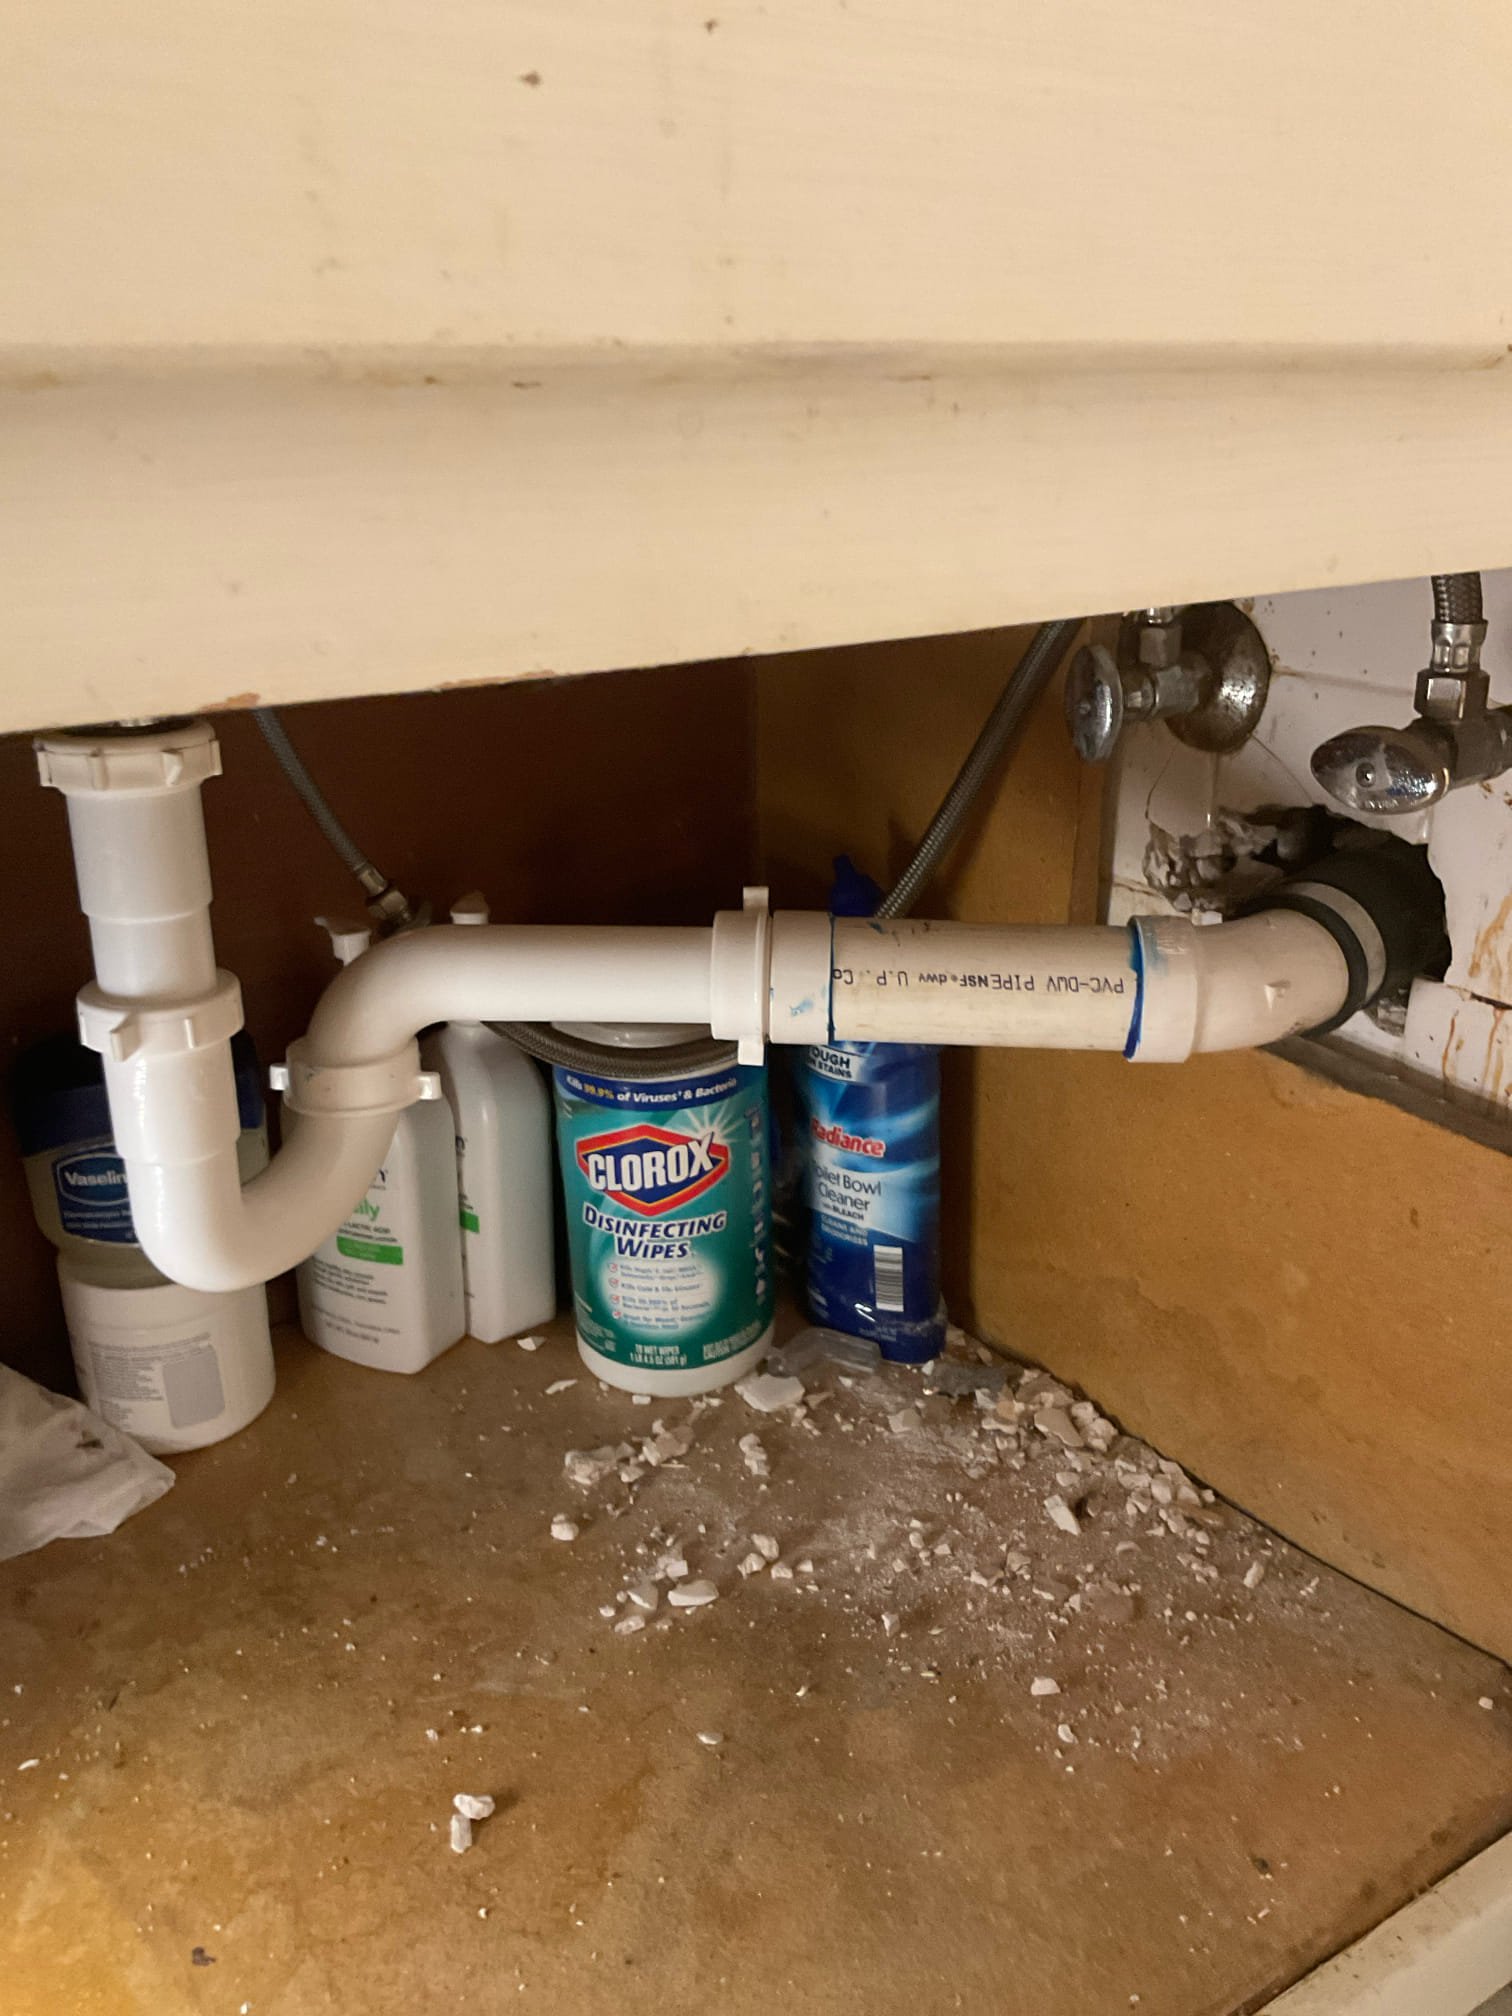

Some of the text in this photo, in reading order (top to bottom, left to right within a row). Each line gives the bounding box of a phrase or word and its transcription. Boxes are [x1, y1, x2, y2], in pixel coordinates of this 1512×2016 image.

[1047, 975, 1124, 994] PVC-DWV
[810, 1045, 850, 1069] OUGH
[818, 1060, 853, 1079] STAINS
[617, 1091, 631, 1102] of
[683, 1090, 693, 1100] &
[811, 1116, 884, 1156] Radiance
[588, 1131, 716, 1191] CLOROX
[64, 1169, 129, 1187] Vaselin
[813, 1164, 882, 1197] oilet Bowl
[818, 1182, 871, 1211] Cleaner
[584, 1203, 727, 1238] DISINFECTING
[615, 1236, 689, 1259] WIPES
